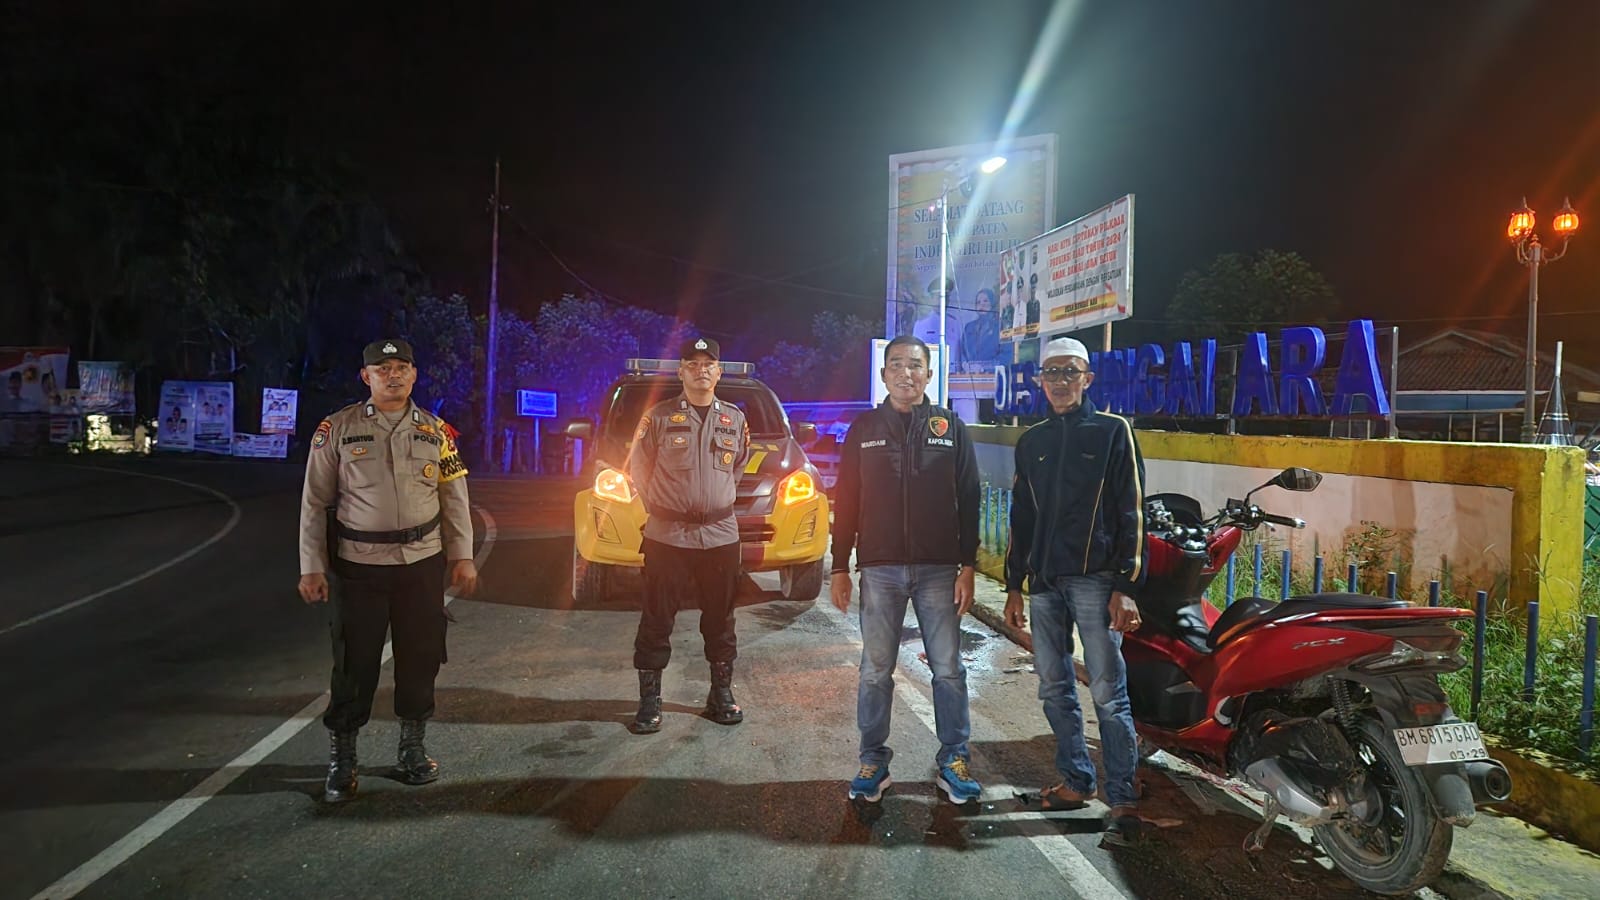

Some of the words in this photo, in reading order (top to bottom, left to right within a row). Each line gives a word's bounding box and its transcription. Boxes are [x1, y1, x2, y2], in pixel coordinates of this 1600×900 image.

[1106, 231, 1121, 246] 2024
[1234, 319, 1391, 416] ARA
[1397, 729, 1418, 747] BM
[1418, 726, 1453, 745] 6815
